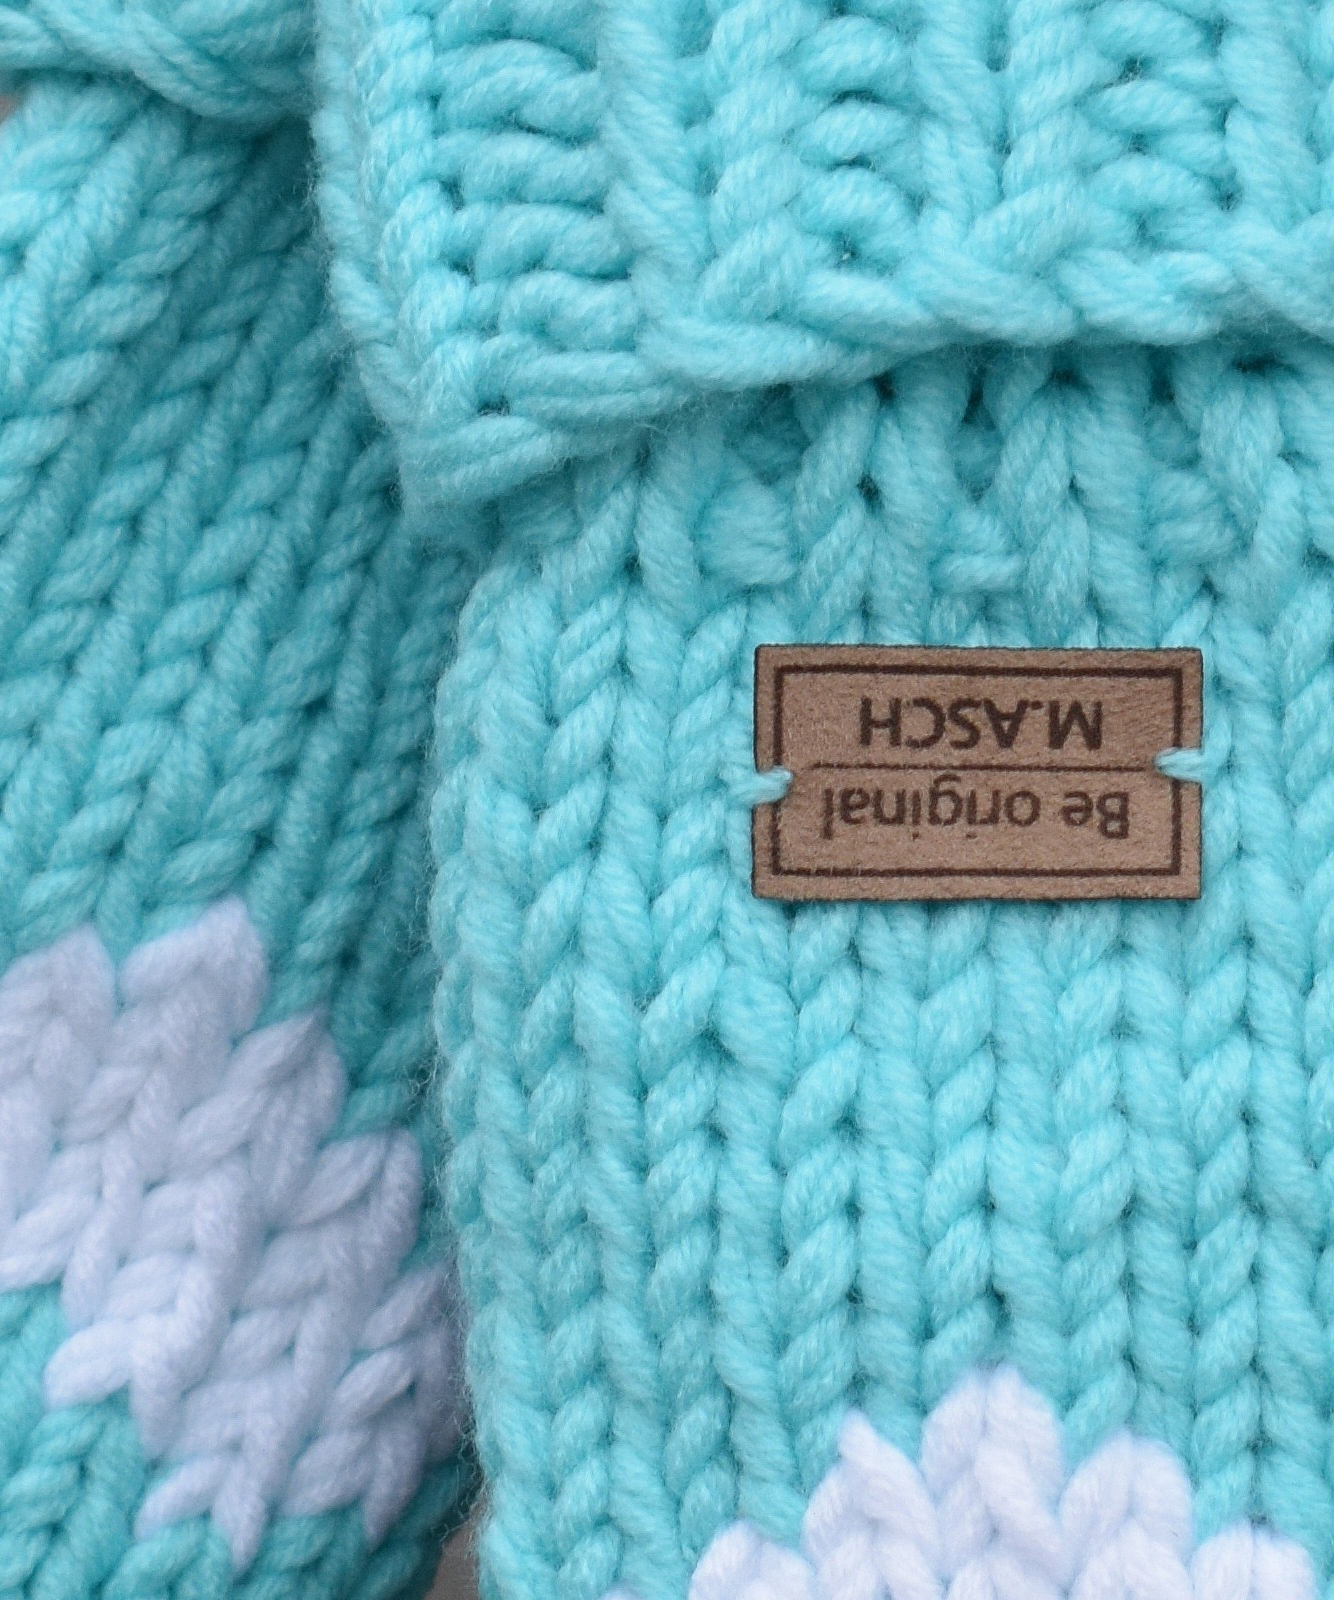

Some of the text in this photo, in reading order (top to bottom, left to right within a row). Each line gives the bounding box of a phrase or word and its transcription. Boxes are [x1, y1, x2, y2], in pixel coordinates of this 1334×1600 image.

[858, 696, 1104, 751] M.ASCH
[821, 773, 1130, 840] Be original
